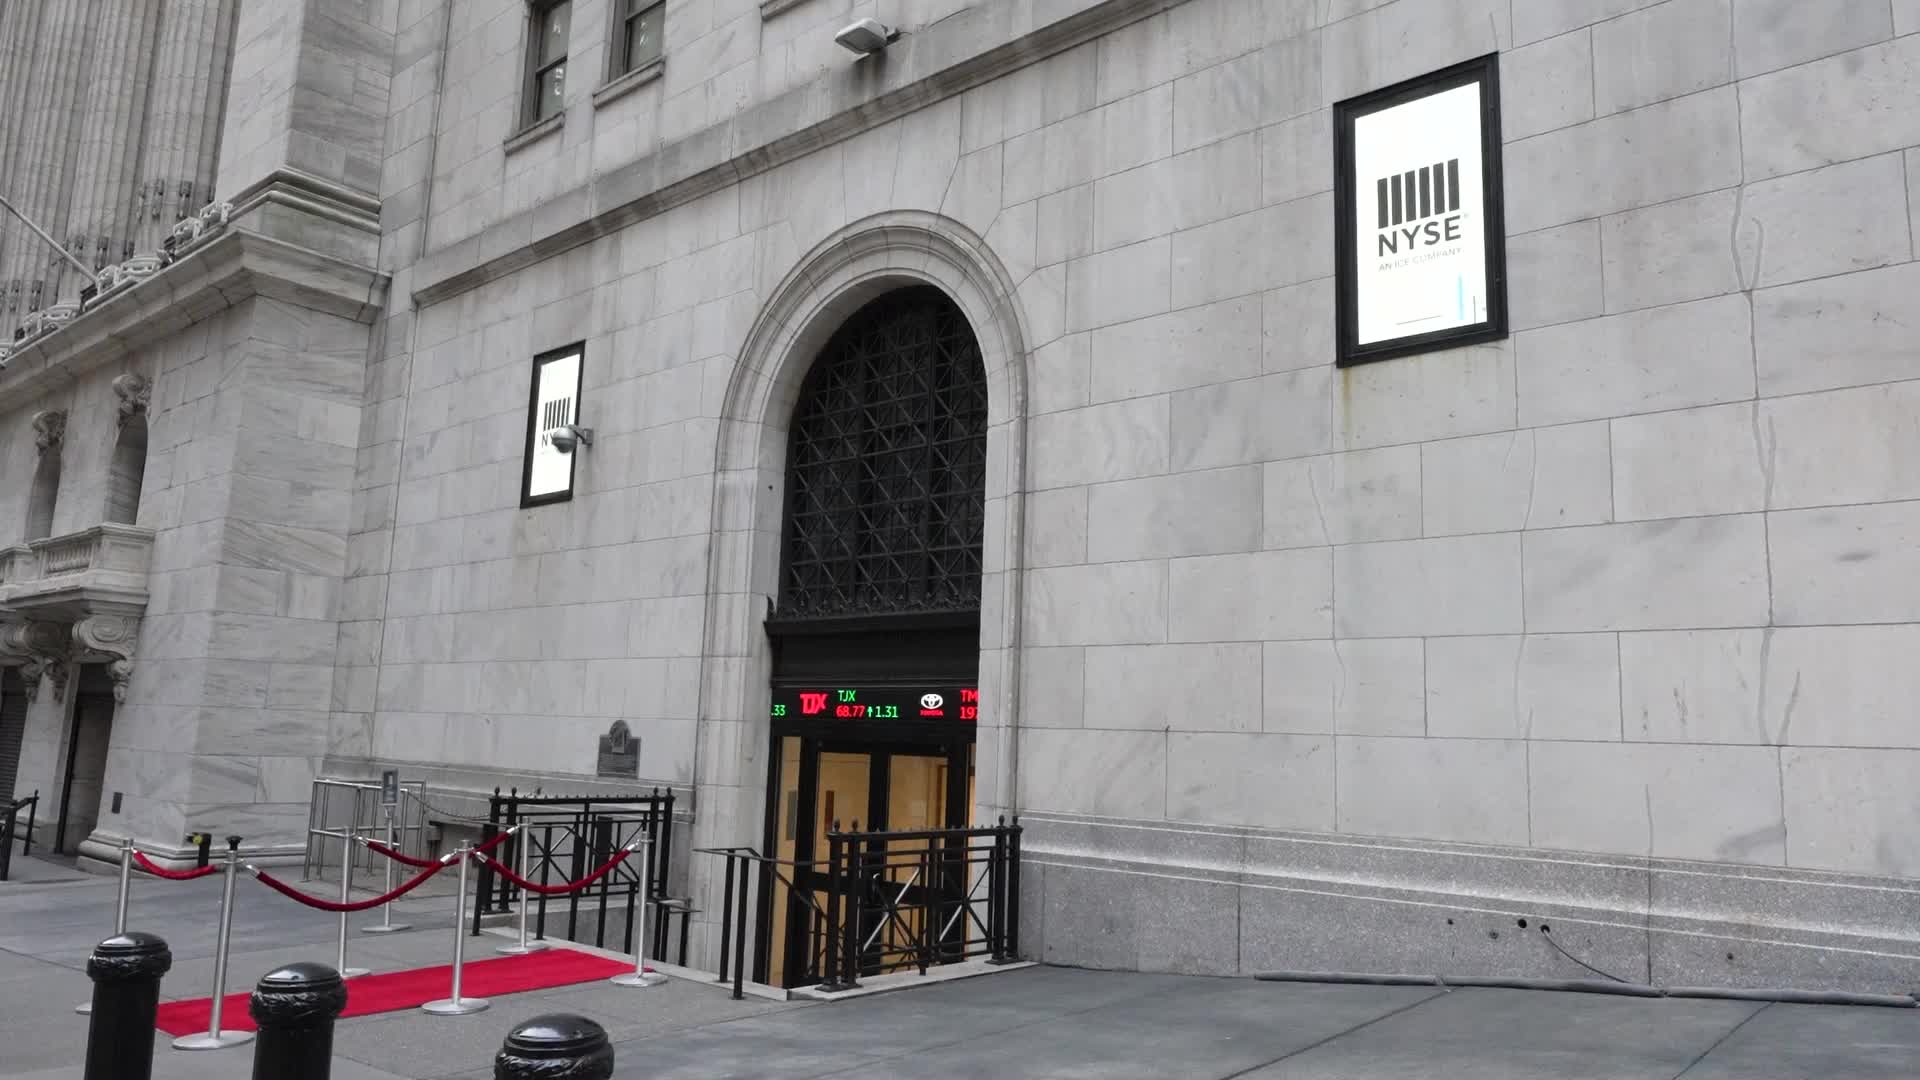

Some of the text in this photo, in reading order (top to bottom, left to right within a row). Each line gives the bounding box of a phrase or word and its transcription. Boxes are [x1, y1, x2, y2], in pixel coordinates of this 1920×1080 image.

[1378, 214, 1462, 257] NYSE
[837, 690, 856, 702] TJX
[836, 705, 899, 718] 68.77 1.31
